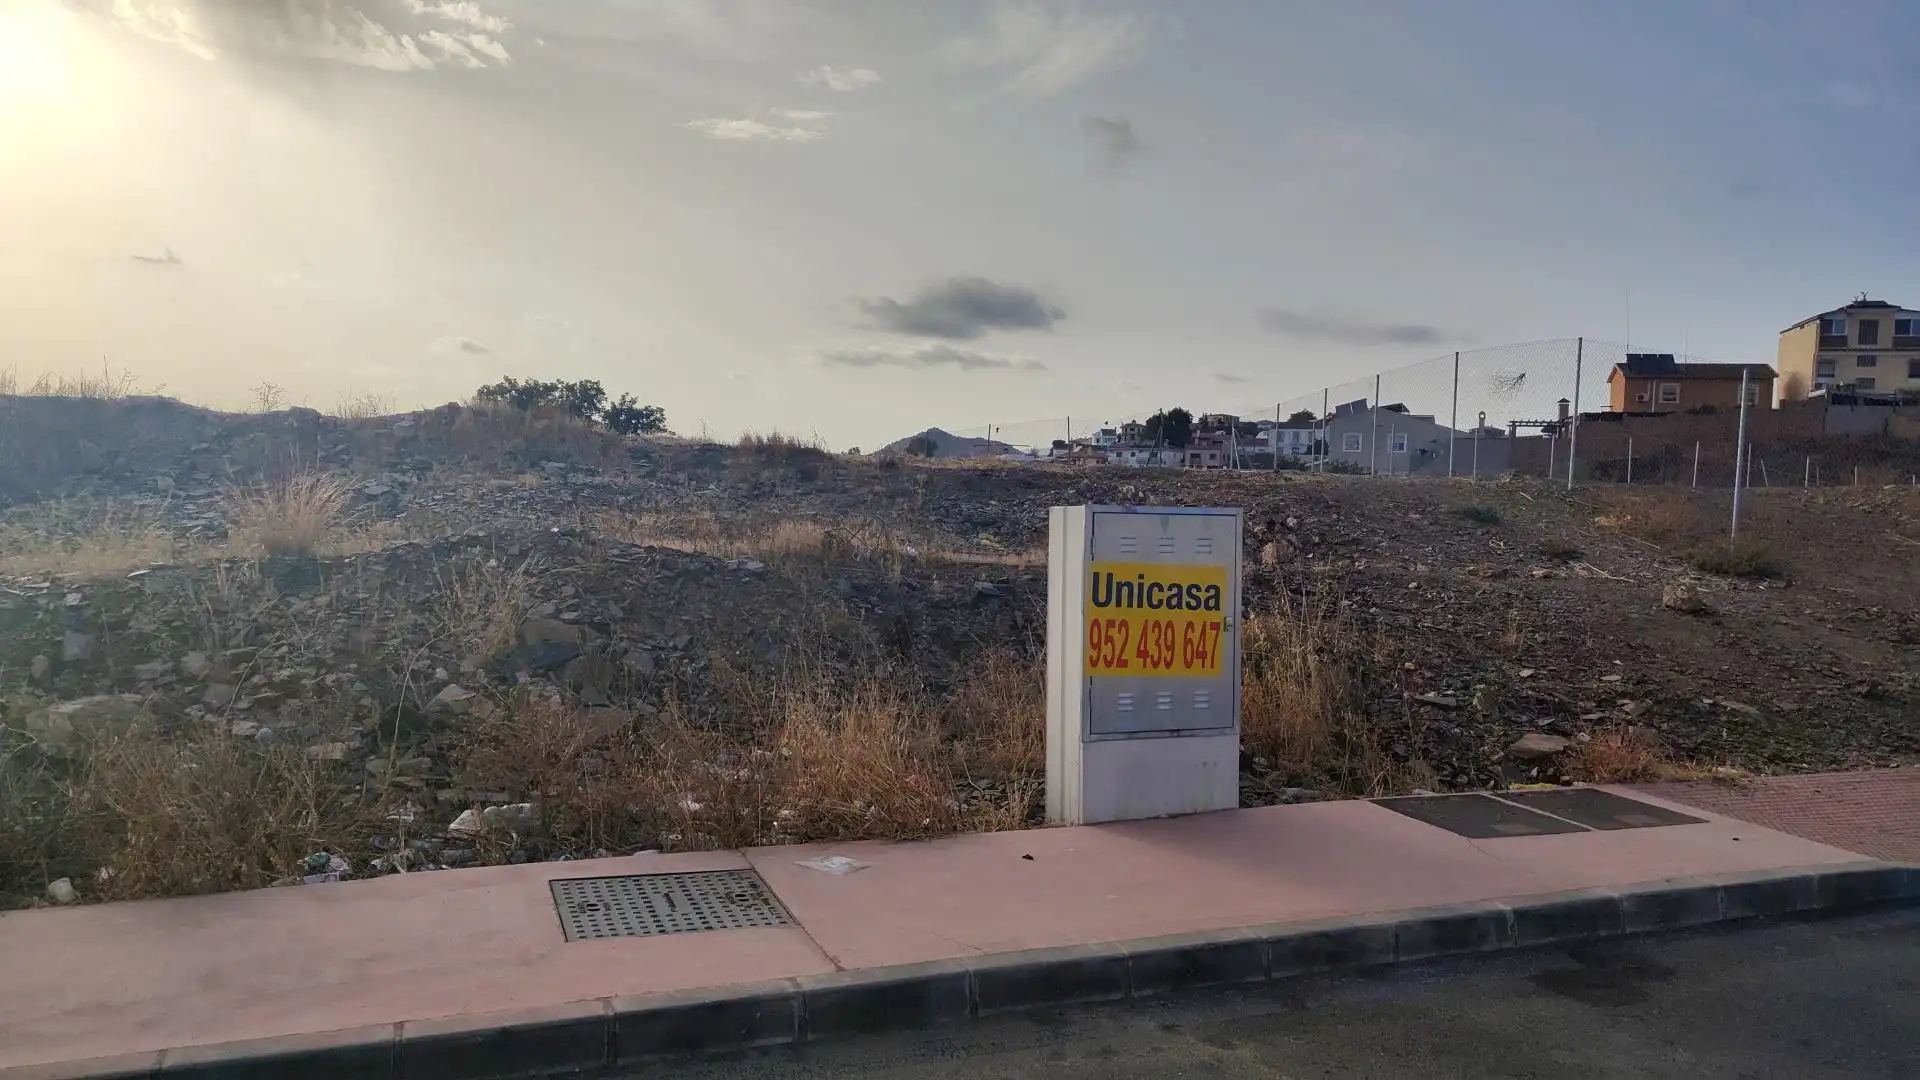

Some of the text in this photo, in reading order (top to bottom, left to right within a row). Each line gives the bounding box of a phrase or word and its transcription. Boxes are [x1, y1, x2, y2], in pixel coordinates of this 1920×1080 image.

[1092, 572, 1220, 611] Unicasa
[1089, 618, 1221, 669] 952 439 647
